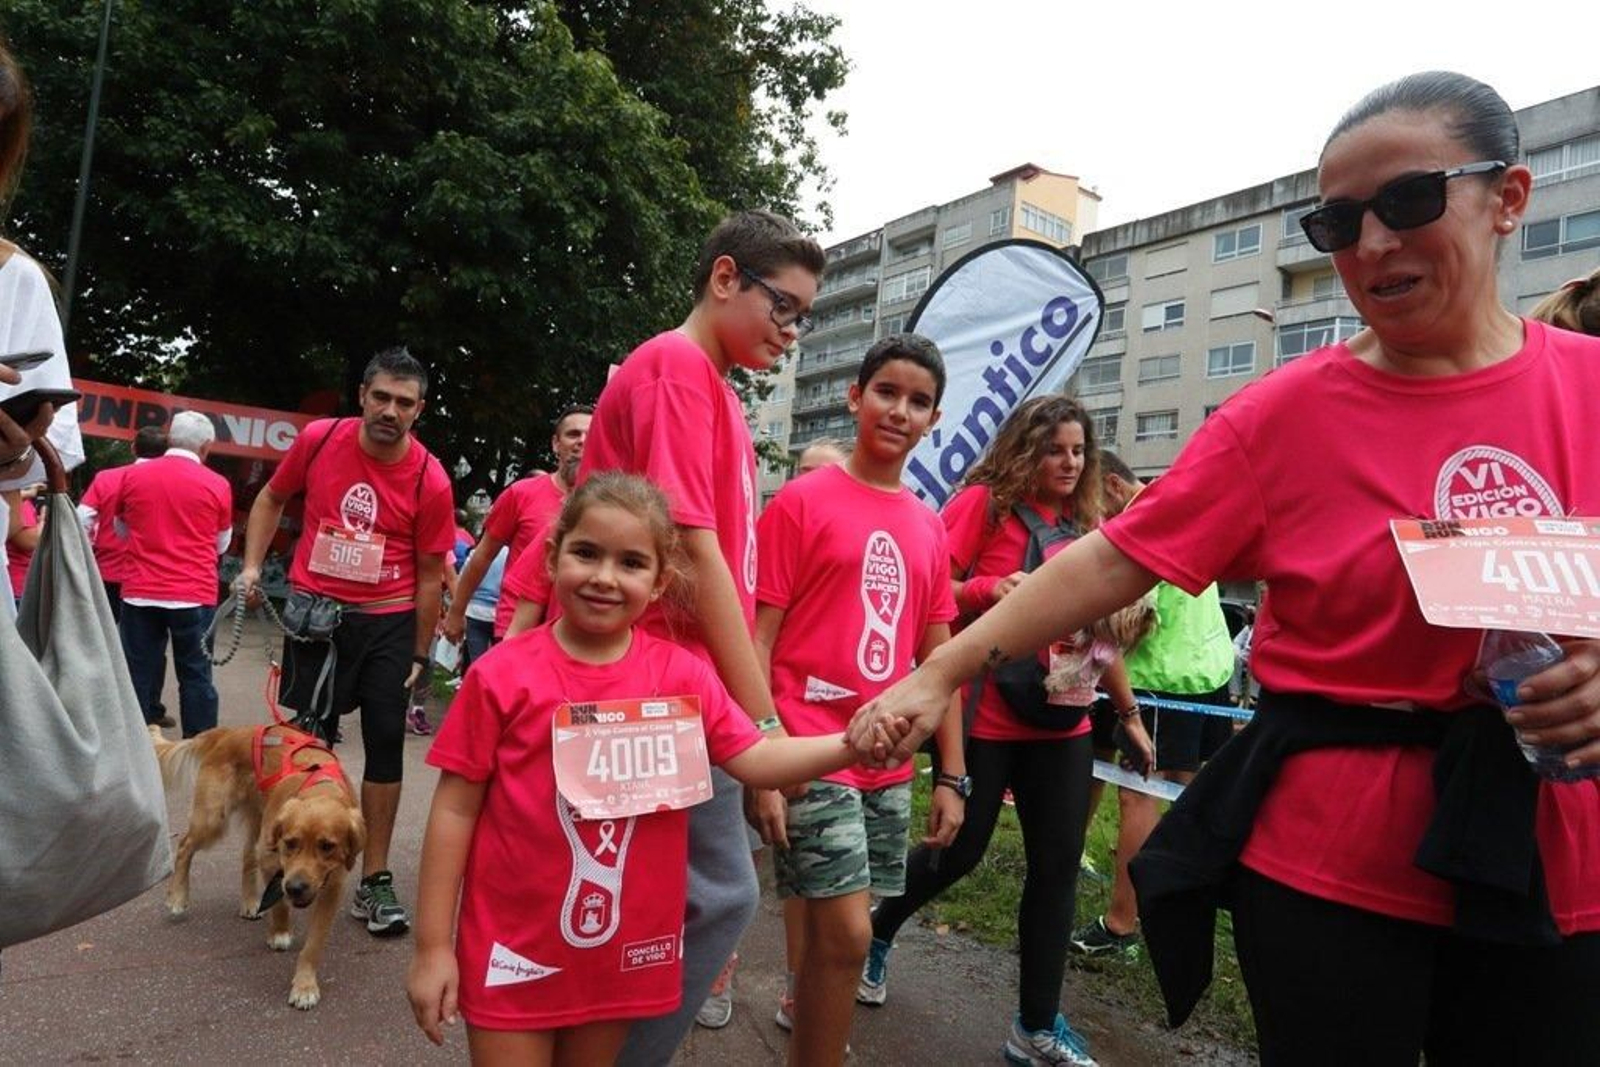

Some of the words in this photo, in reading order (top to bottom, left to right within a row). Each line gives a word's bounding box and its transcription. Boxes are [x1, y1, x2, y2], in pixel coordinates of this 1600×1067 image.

[907, 296, 1079, 513] lántico
[77, 392, 131, 429] UN
[223, 413, 298, 451] VIG
[1458, 461, 1506, 490] VI
[1452, 497, 1543, 519] VIGO
[329, 543, 363, 567] 5115
[874, 540, 890, 556] VI
[867, 562, 897, 577] VIGO
[1481, 549, 1600, 598] 4011
[570, 704, 598, 716] RUN
[571, 713, 599, 725] RUN
[586, 734, 678, 783] 4009
[627, 942, 672, 958] CONCELLO
[631, 956, 644, 965] DE
